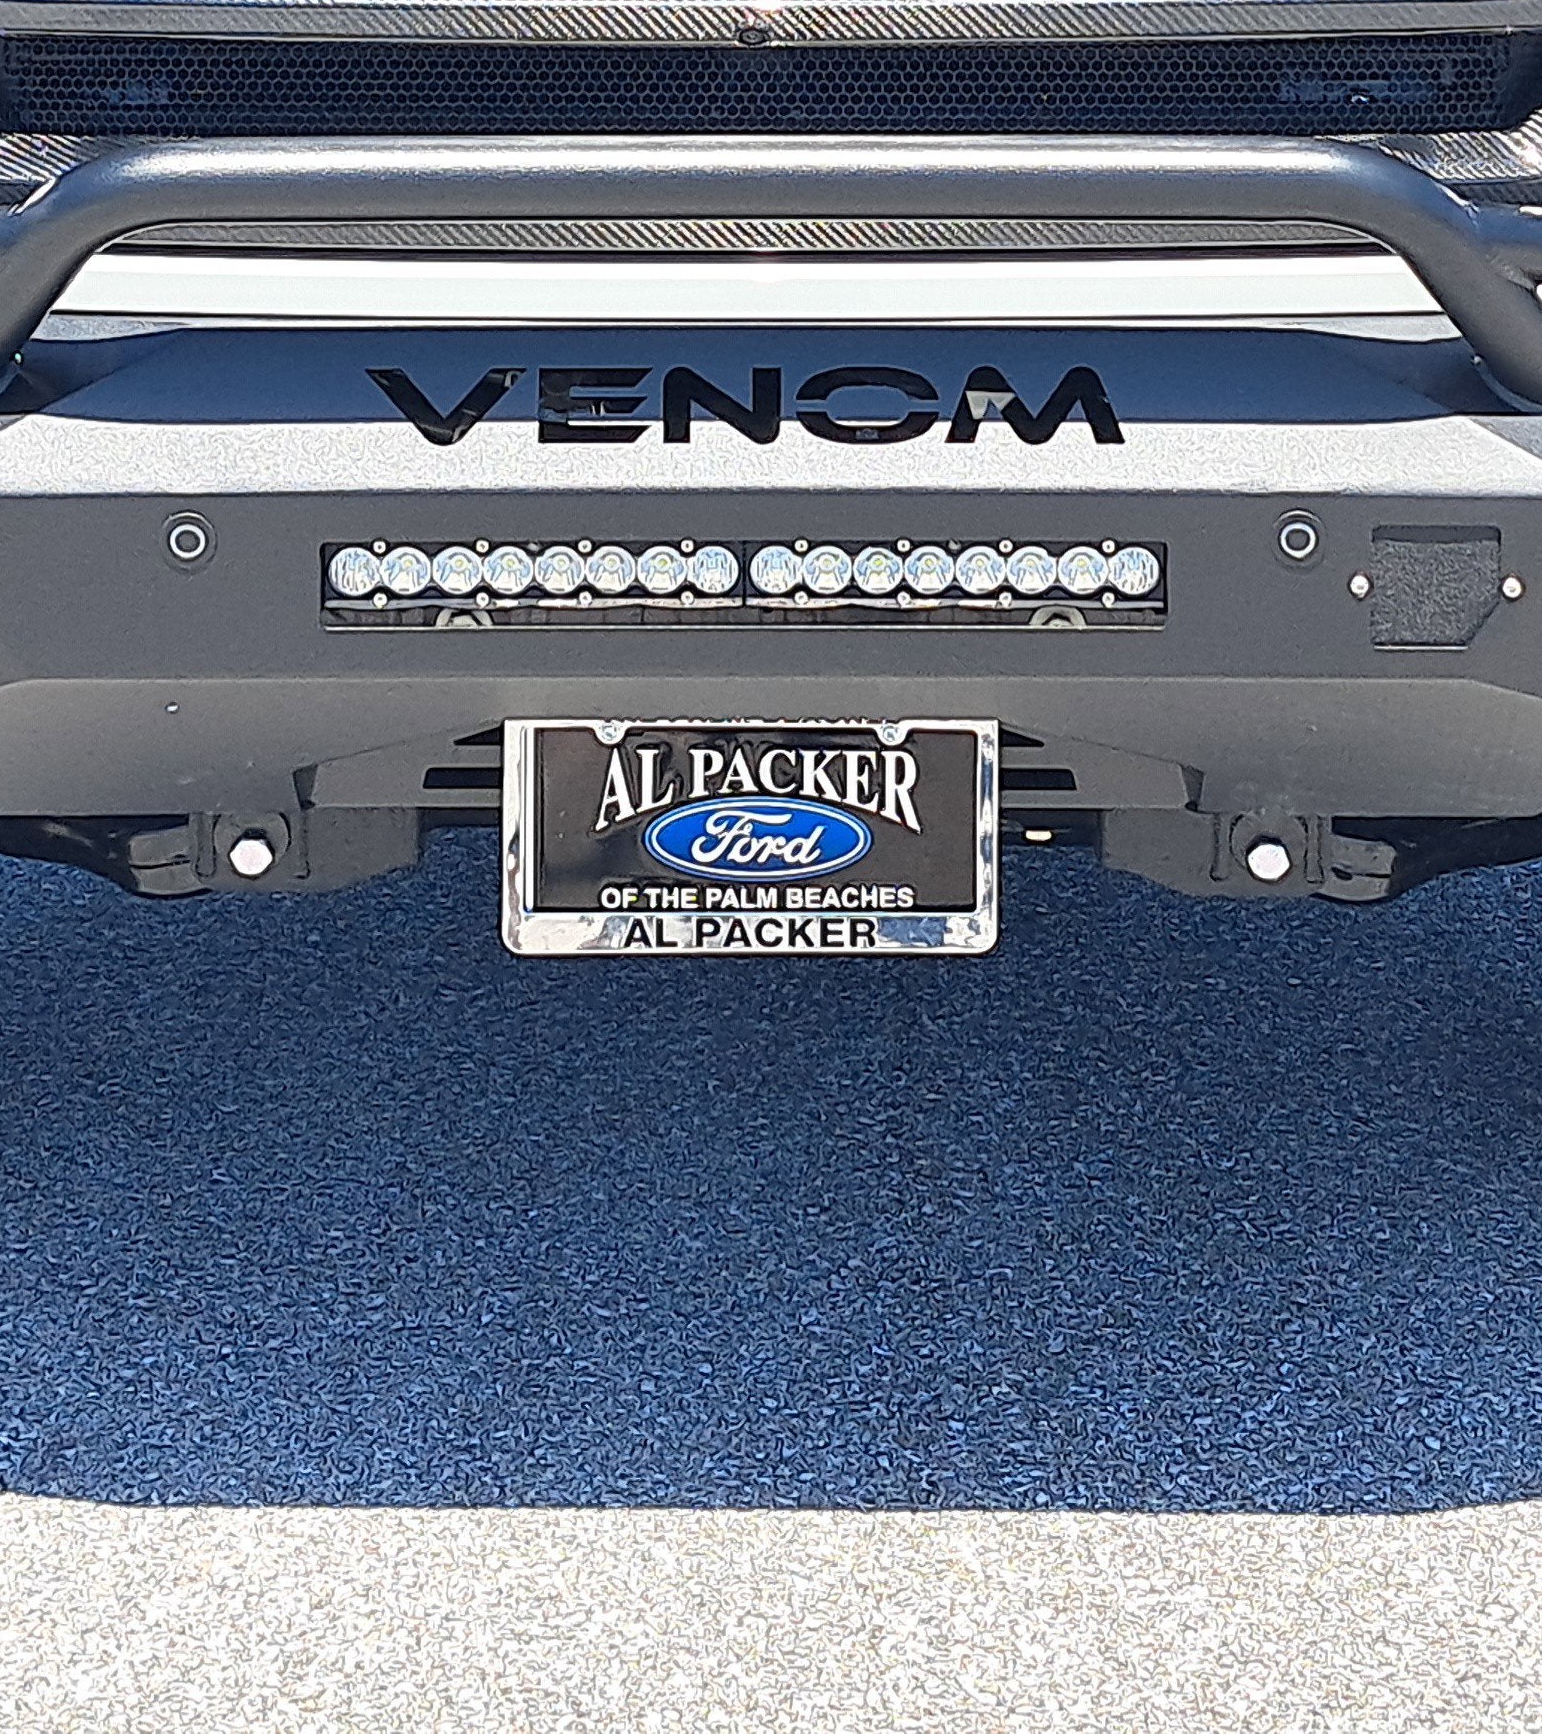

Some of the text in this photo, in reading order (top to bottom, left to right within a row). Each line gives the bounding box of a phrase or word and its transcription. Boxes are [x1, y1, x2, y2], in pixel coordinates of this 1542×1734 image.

[364, 365, 1126, 447] VENOM
[593, 746, 923, 835] AL PACKER
[690, 809, 826, 867] Ford
[600, 887, 915, 909] OF THE PALM BEACHES
[624, 918, 877, 948] AL PACKER
